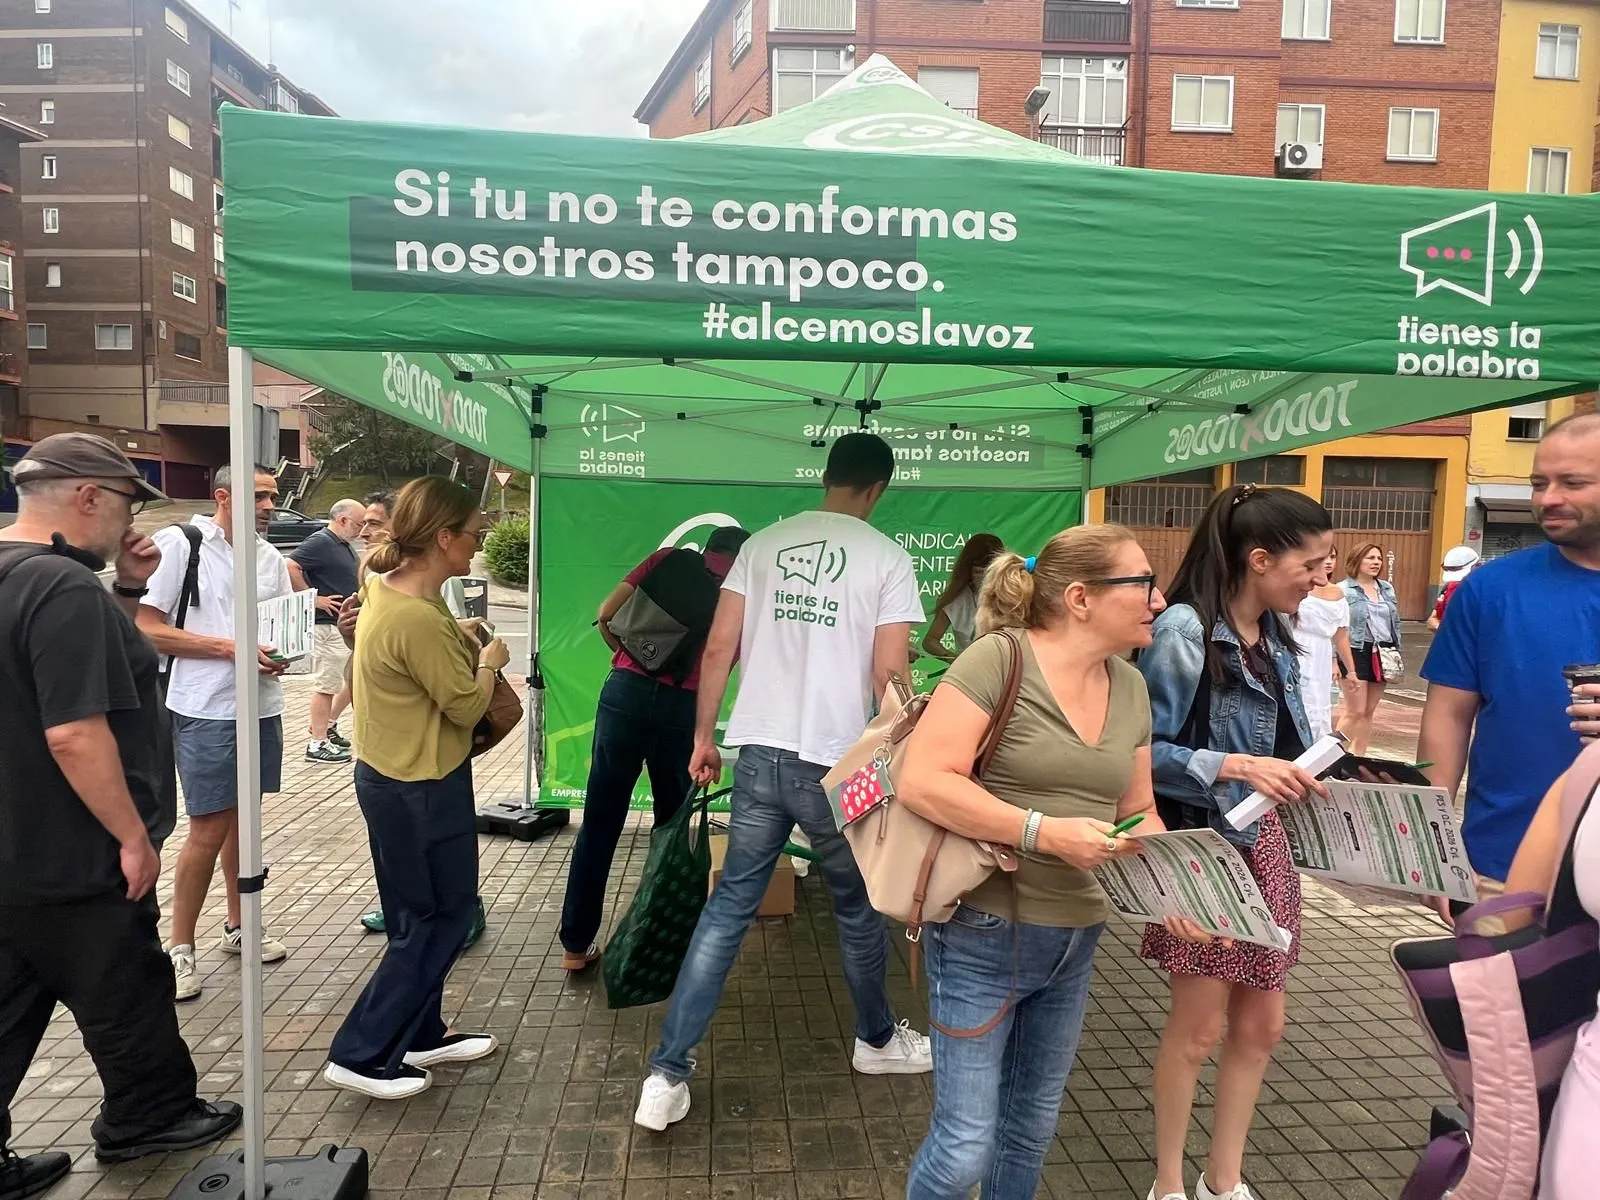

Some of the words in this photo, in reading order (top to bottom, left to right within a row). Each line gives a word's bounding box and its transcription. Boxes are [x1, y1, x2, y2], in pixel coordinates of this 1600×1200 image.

[393, 169, 450, 217] Si
[470, 177, 527, 221] tu
[548, 191, 618, 225] no
[636, 184, 693, 228] te
[711, 184, 1018, 242] conformas
[395, 236, 655, 282] nosotros
[671, 241, 945, 303] tampoco.
[702, 301, 1034, 350] #alcemoslavoz
[1397, 315, 1499, 348] tienes
[1396, 348, 1540, 381] palabra
[895, 532, 972, 549] SINDICA
[822, 595, 839, 612] la
[551, 788, 587, 798] EMPRES
